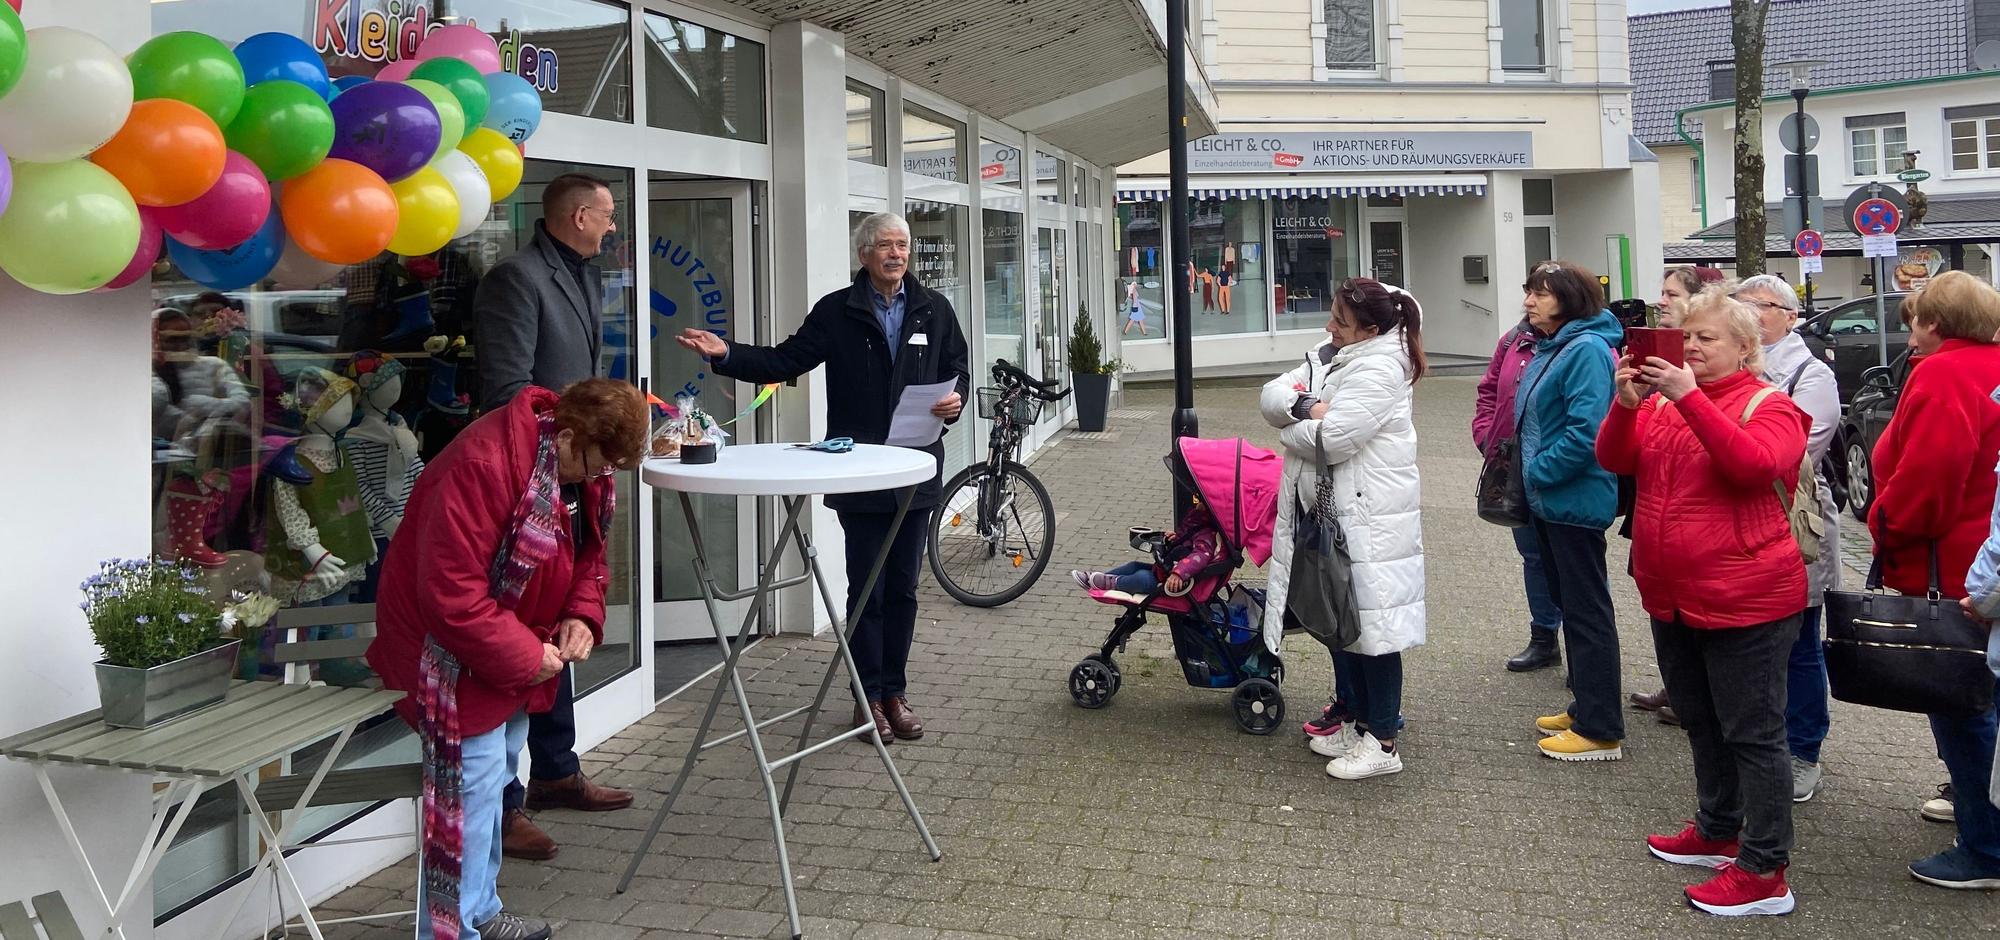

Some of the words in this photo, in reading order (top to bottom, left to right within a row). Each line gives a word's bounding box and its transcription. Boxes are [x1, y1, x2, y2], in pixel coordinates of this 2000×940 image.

[313, 0, 559, 93] Kleidden
[1193, 139, 1243, 151] LEICHT
[1247, 138, 1258, 151] &
[1261, 139, 1285, 151] CO.
[1313, 140, 1333, 151] IHR
[1336, 139, 1388, 151] PARTNER
[1391, 137, 1414, 151] FÜR
[1194, 160, 1273, 168] Einzelhandelsberatung
[1313, 154, 1370, 166] AKTIONS-
[1372, 154, 1399, 165] UND
[1402, 151, 1526, 165] RÄUMUNGSVERKÄUFE
[1275, 217, 1308, 227] LEICHT
[1309, 216, 1316, 227] &
[1318, 216, 1334, 227] CO.
[1503, 211, 1512, 223] 59
[1368, 760, 1392, 770] TOMMY
